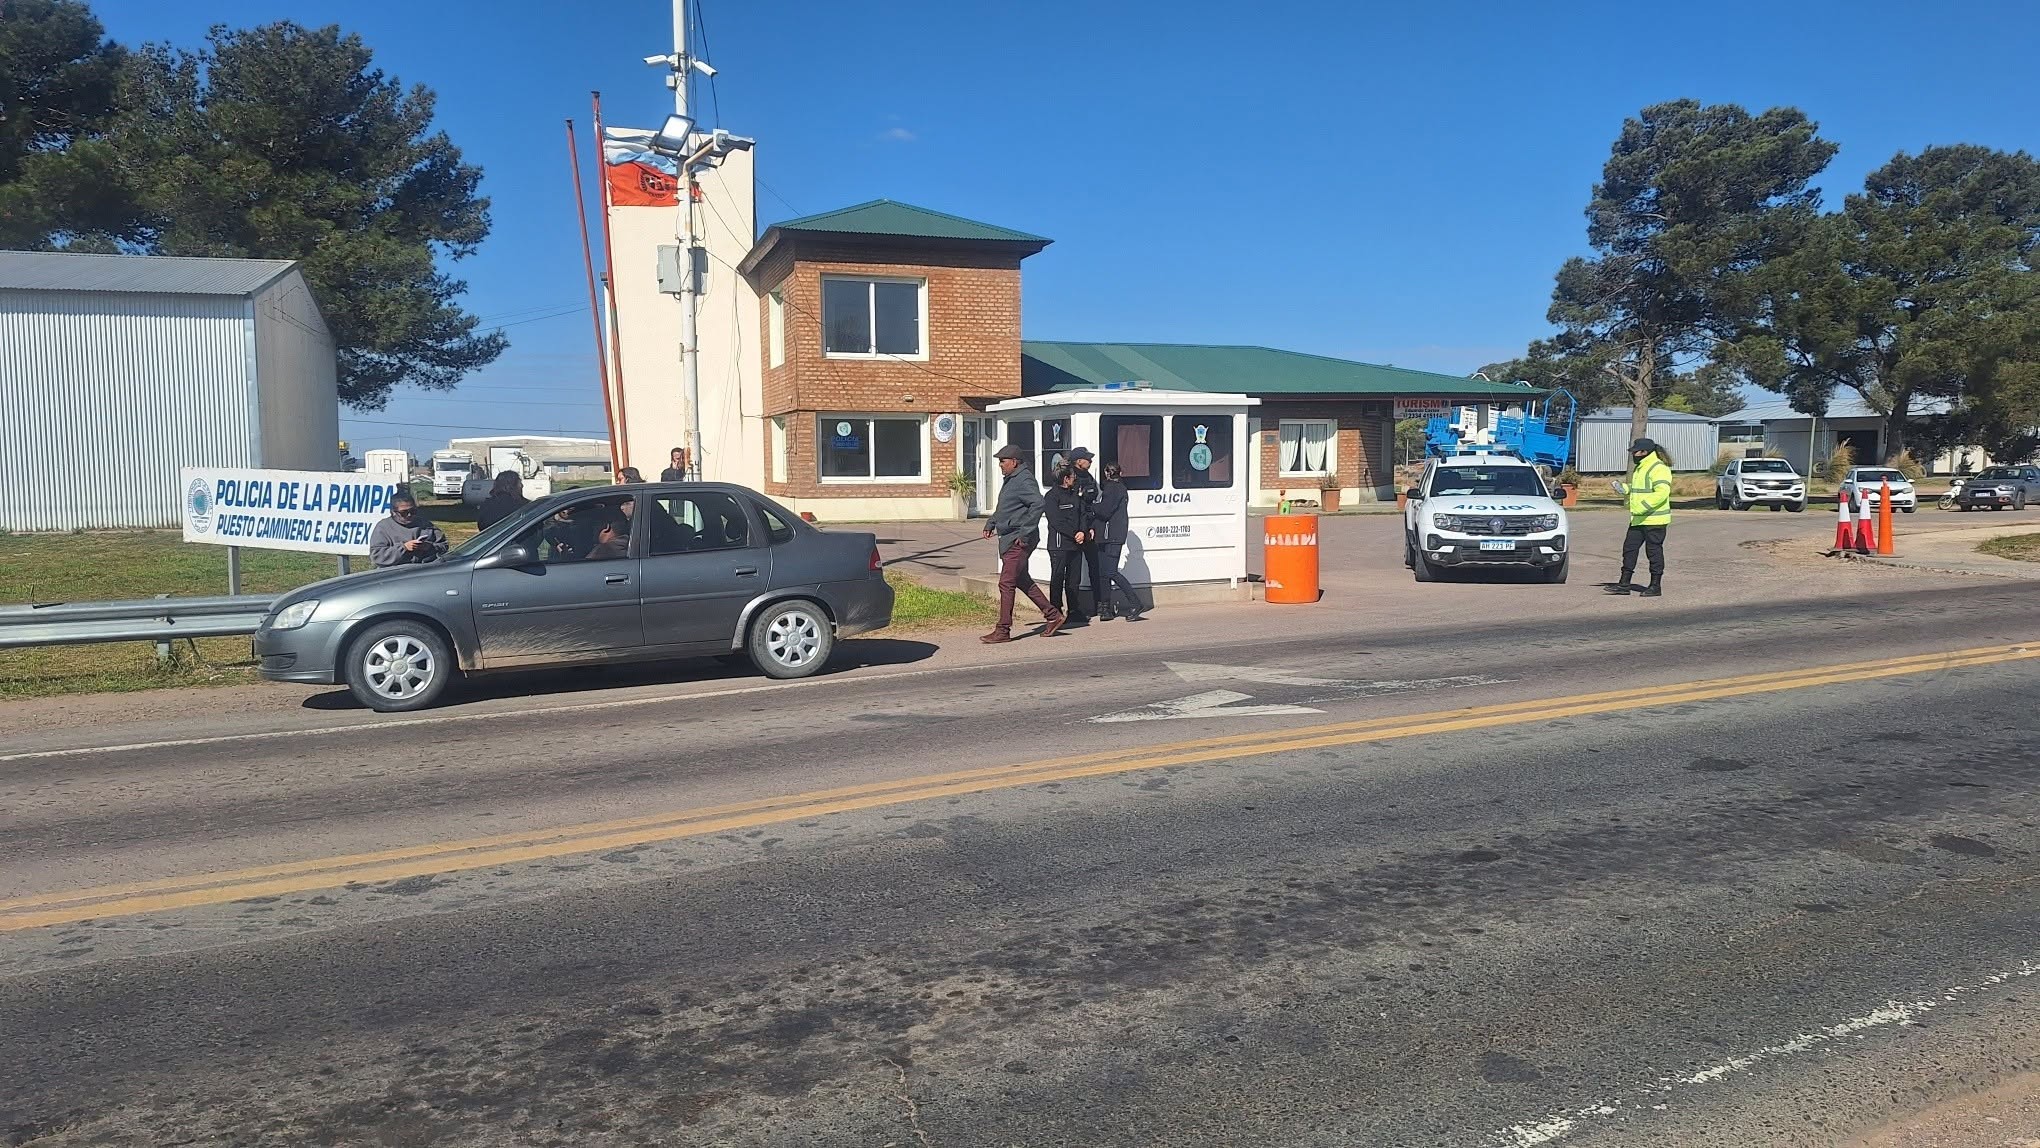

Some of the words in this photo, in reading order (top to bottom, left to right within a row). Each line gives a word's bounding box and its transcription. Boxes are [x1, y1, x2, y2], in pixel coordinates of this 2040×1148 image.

[215, 479, 273, 508] POLICIA
[277, 483, 299, 510] DE
[303, 484, 323, 512] LA
[327, 485, 395, 514] PAMPA
[1147, 493, 1191, 504] POLICIA
[216, 514, 254, 536] PUESTO
[256, 517, 312, 541] CAMINERO
[313, 523, 322, 542] E.
[326, 522, 372, 544] CASTEX
